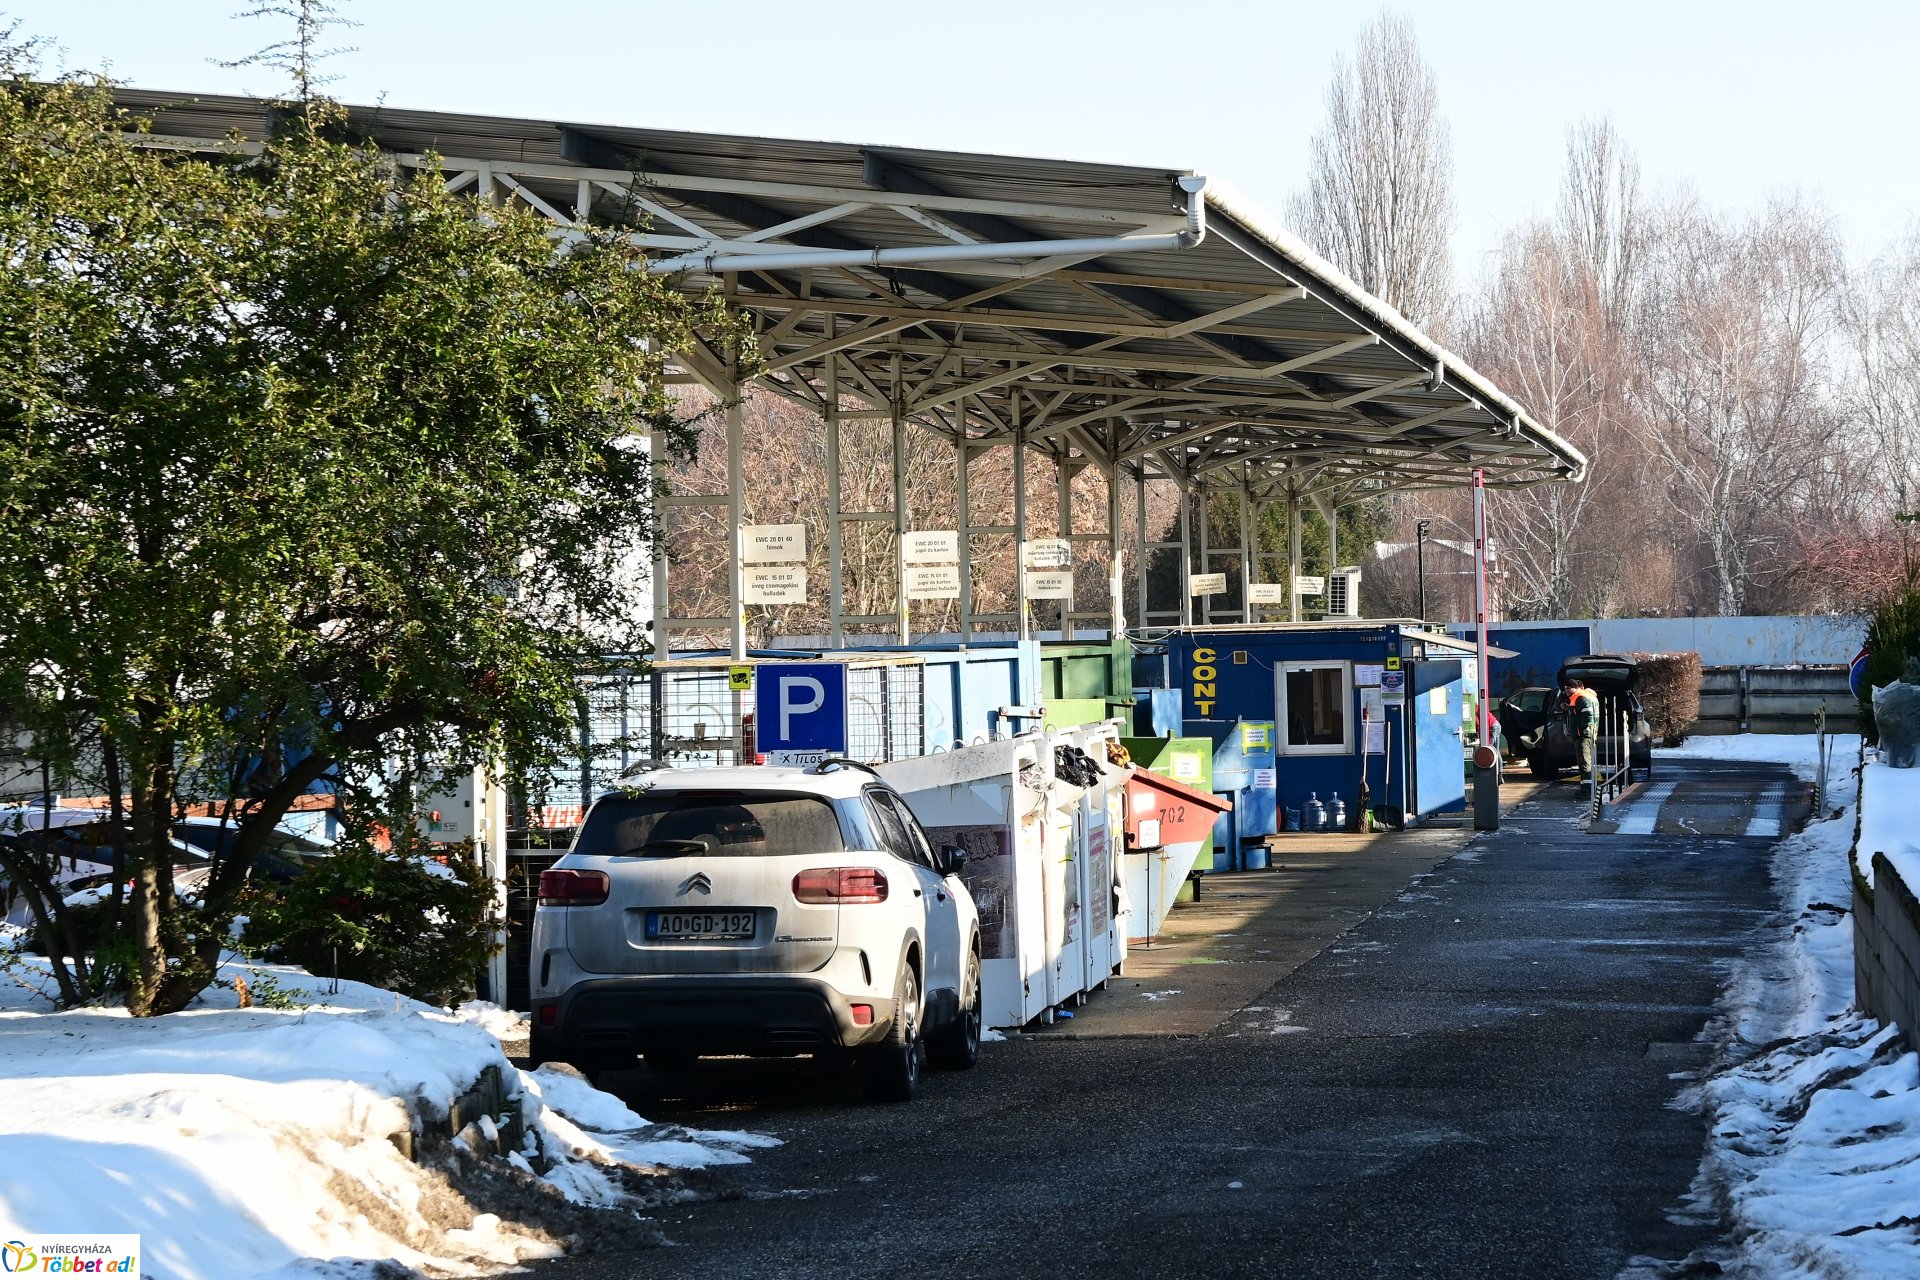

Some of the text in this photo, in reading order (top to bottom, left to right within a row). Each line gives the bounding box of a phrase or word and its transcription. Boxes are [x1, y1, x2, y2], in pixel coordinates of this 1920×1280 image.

[1192, 647, 1217, 716] CONT
[779, 676, 825, 741] P
[793, 752, 823, 764] TILOS
[1159, 805, 1185, 826] 702
